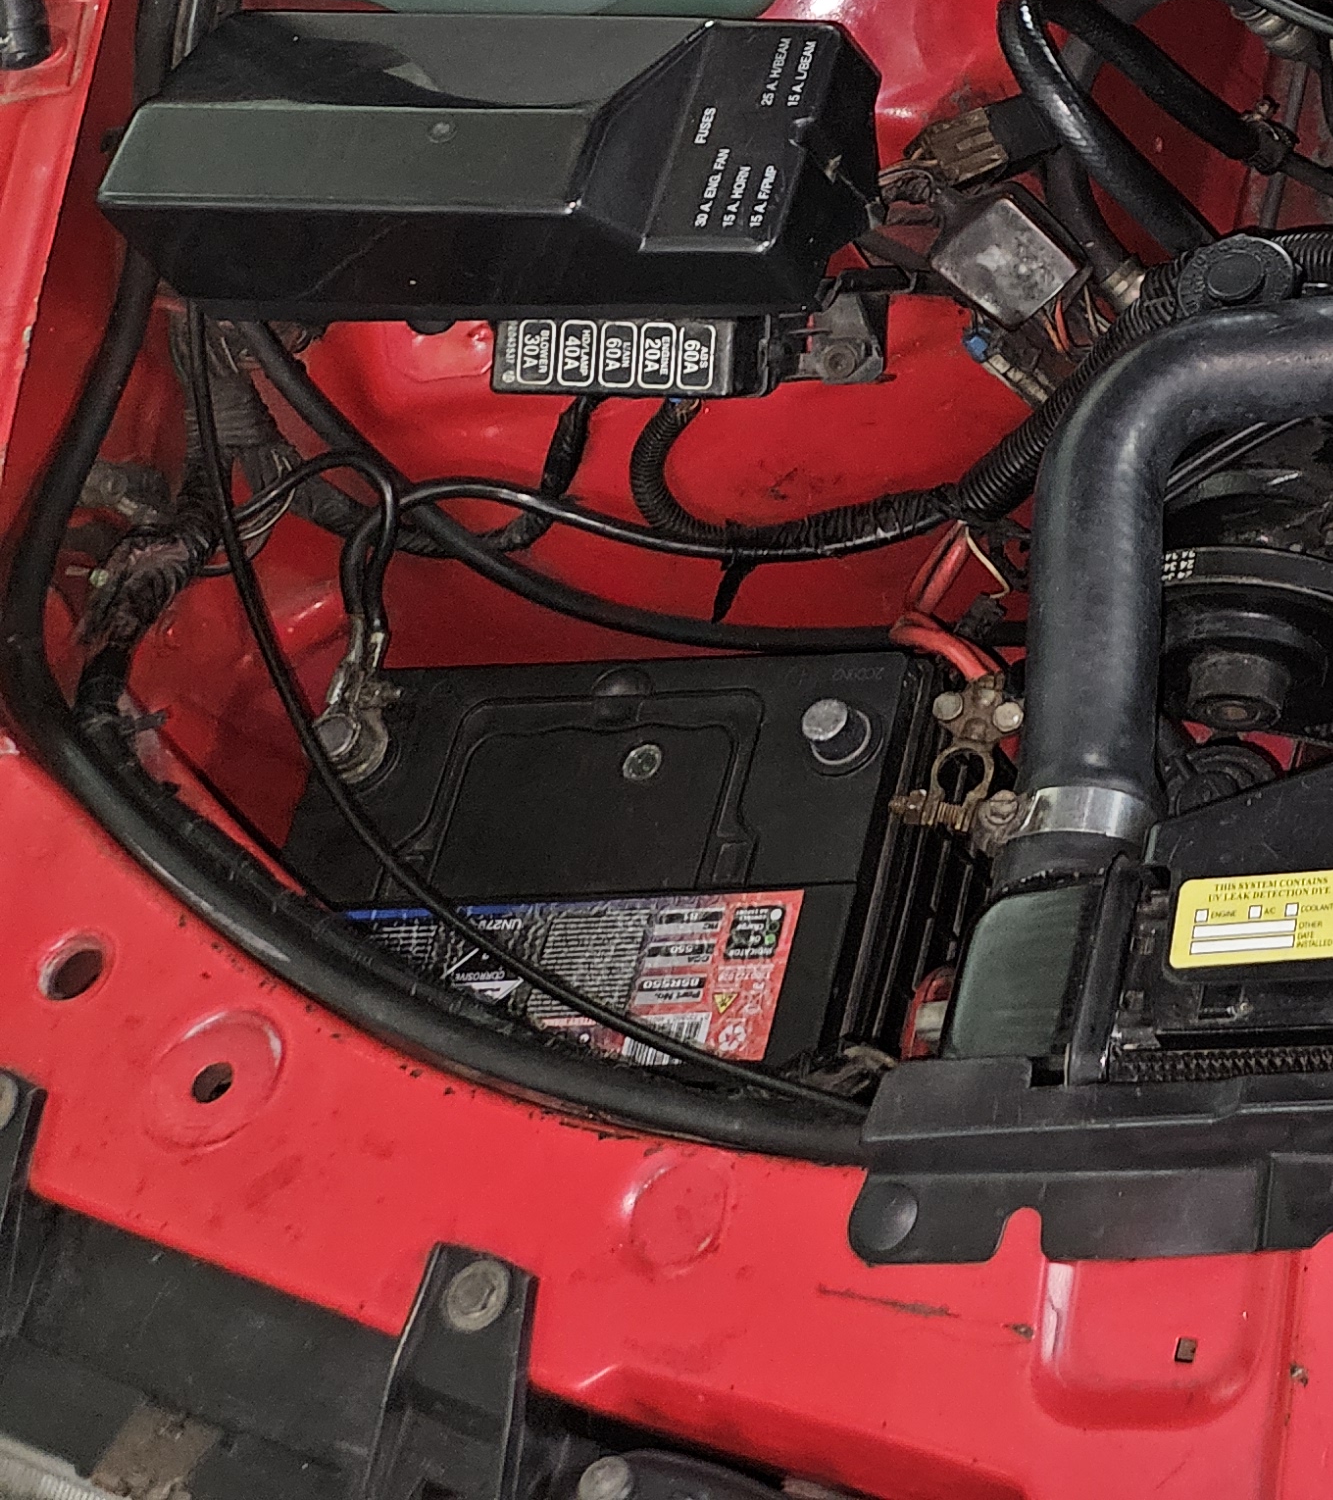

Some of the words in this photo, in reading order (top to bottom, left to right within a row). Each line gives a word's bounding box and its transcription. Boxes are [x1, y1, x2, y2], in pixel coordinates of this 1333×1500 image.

[761, 93, 775, 106] 25
[769, 37, 792, 78] H/BEAM
[787, 95, 800, 106] 15
[795, 40, 817, 80] L/BEAM
[694, 107, 717, 144] FUSES
[694, 213, 709, 227] 30
[703, 171, 723, 198] ENG.
[713, 148, 731, 170] FAN
[722, 214, 736, 227] 15
[730, 166, 751, 199] HORN
[750, 215, 763, 227] 15
[757, 164, 778, 199] F/PMP
[522, 334, 540, 369] 30A
[538, 329, 550, 374] BLOWER
[563, 335, 581, 370] 40A
[580, 328, 592, 377] HD/LAMP
[605, 337, 622, 371] 60A
[644, 338, 662, 373] 20A
[660, 336, 671, 376] ENGINE
[683, 339, 700, 374] 60A
[699, 345, 709, 369] ABS
[1208, 894, 1222, 902] UV
[1224, 891, 1251, 901] LEAK
[1252, 887, 1310, 900] DETECTION
[1311, 886, 1331, 896] DYE
[1214, 882, 1237, 892] THIS
[1238, 879, 1277, 890] SYSTEM
[1279, 876, 1329, 888] CONTAINS
[477, 918, 522, 930] UN27
[1210, 909, 1237, 919] ENGINE
[1264, 906, 1277, 915] A/C
[1298, 920, 1324, 929] OTHER
[669, 945, 693, 954] 550
[727, 947, 773, 957] INDICATOR
[1296, 939, 1333, 949] INSTALLED
[1297, 931, 1316, 940] DATE
[454, 970, 506, 980] CORROSIVE
[677, 990, 701, 999] Part
